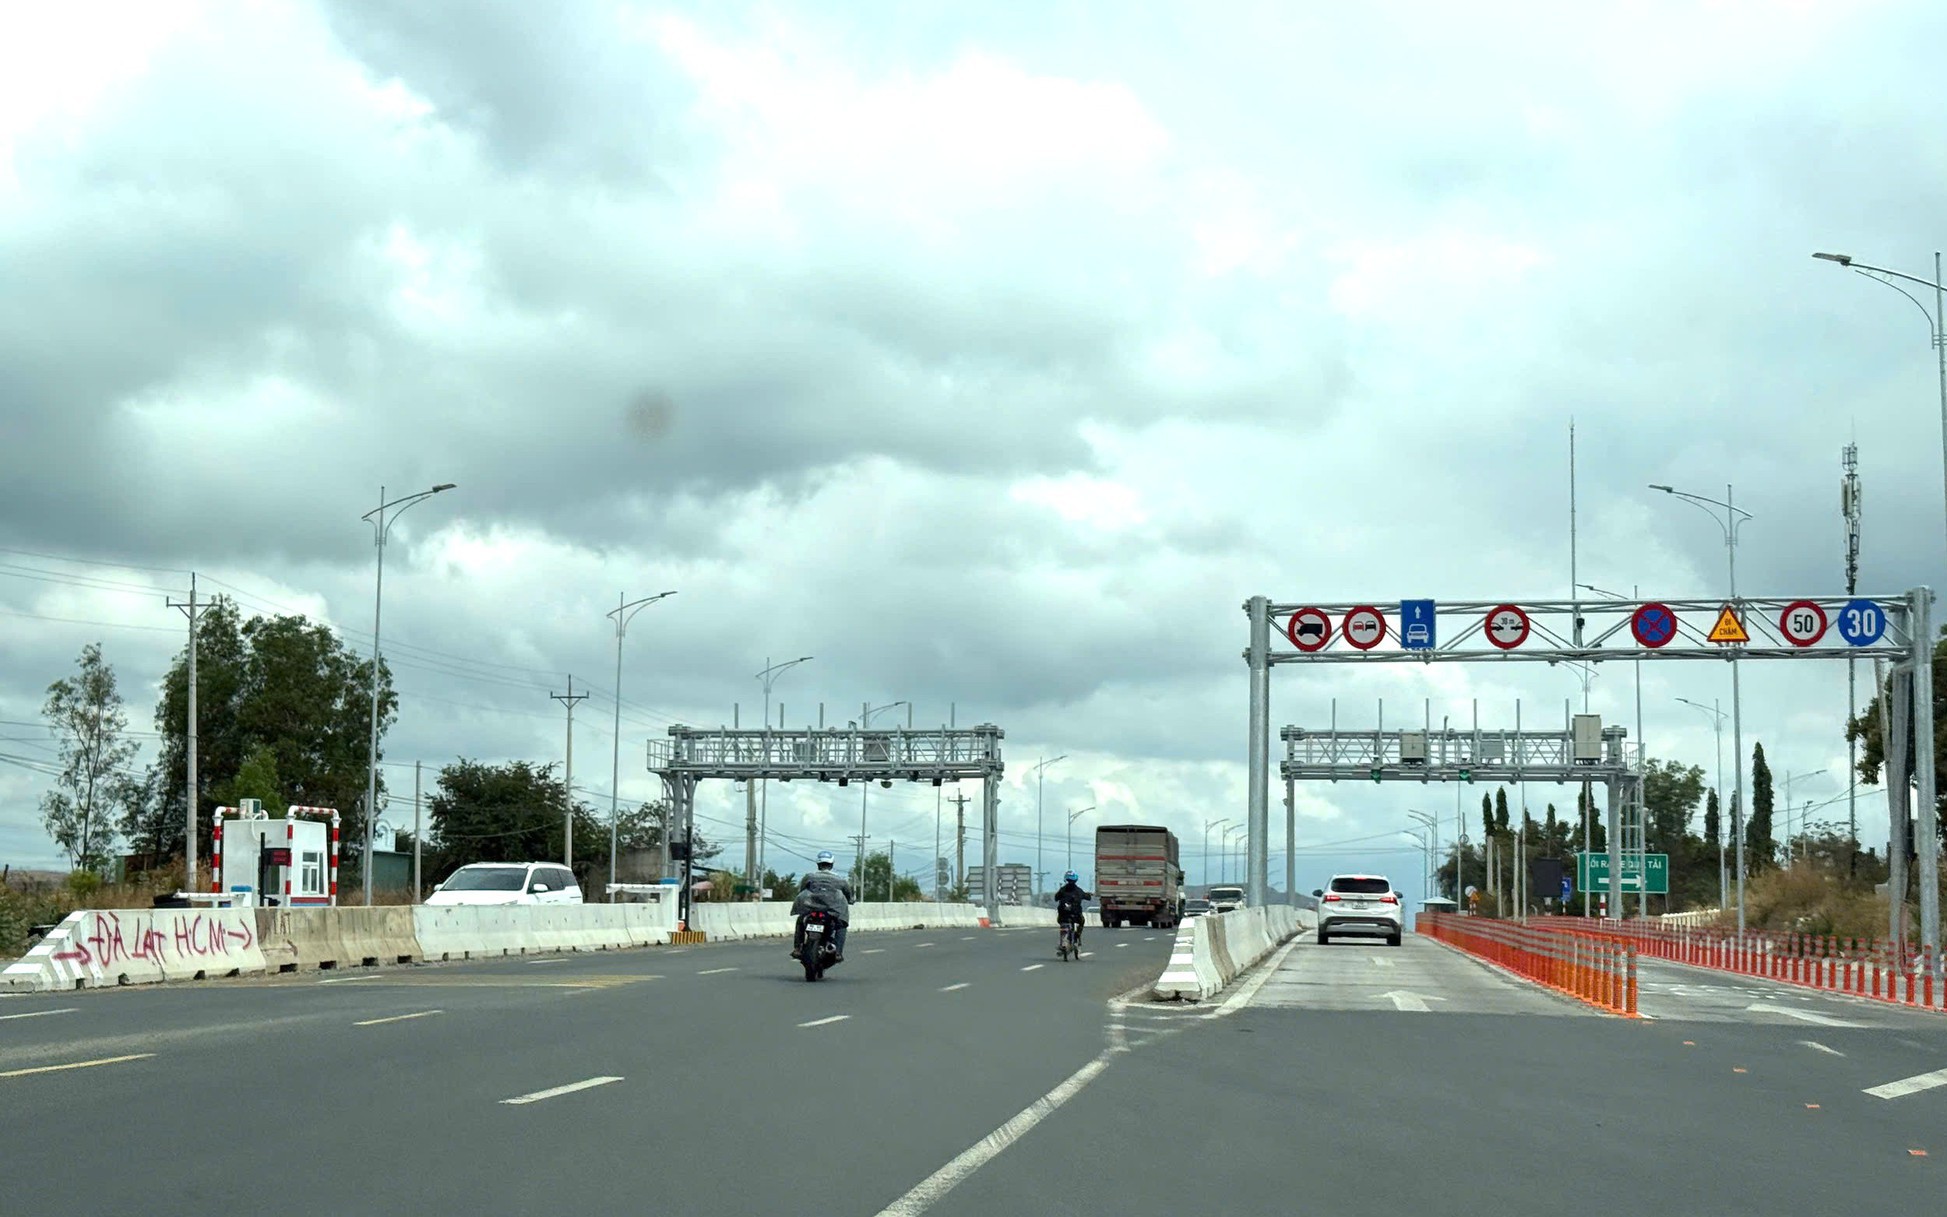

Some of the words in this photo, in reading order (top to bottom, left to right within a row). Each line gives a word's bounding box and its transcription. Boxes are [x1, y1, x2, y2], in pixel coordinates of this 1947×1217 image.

[1793, 613, 1814, 634] 50
[1847, 608, 1876, 638] 30
[1647, 858, 1662, 869] TẢI
